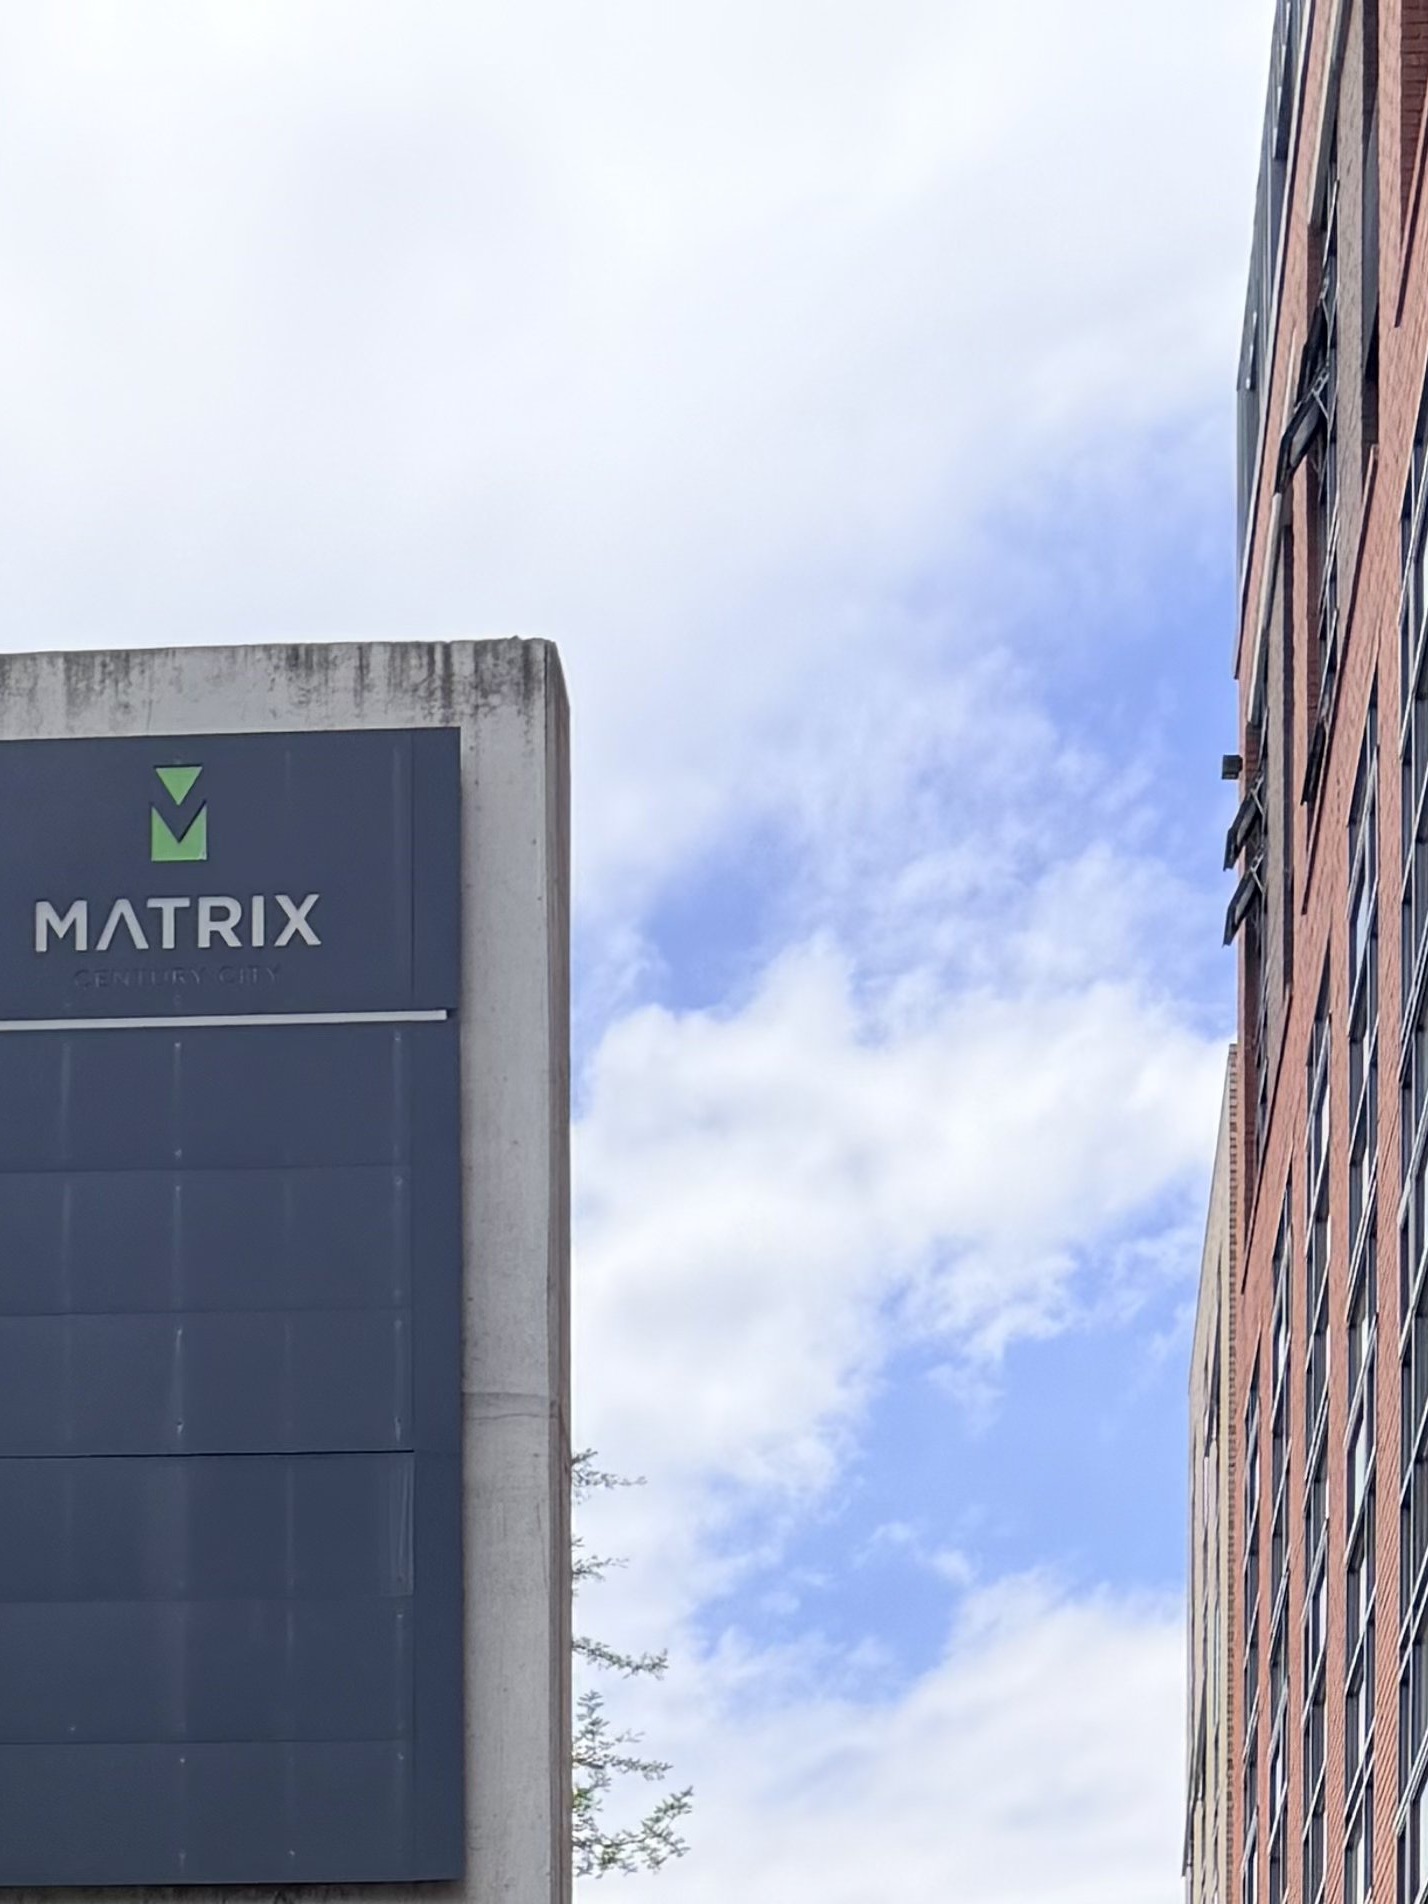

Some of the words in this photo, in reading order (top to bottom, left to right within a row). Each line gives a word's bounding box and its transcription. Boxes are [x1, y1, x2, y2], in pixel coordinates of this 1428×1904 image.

[34, 893, 322, 952] MATRIX
[73, 966, 206, 989] CENTURY
[218, 962, 281, 985] CITY
